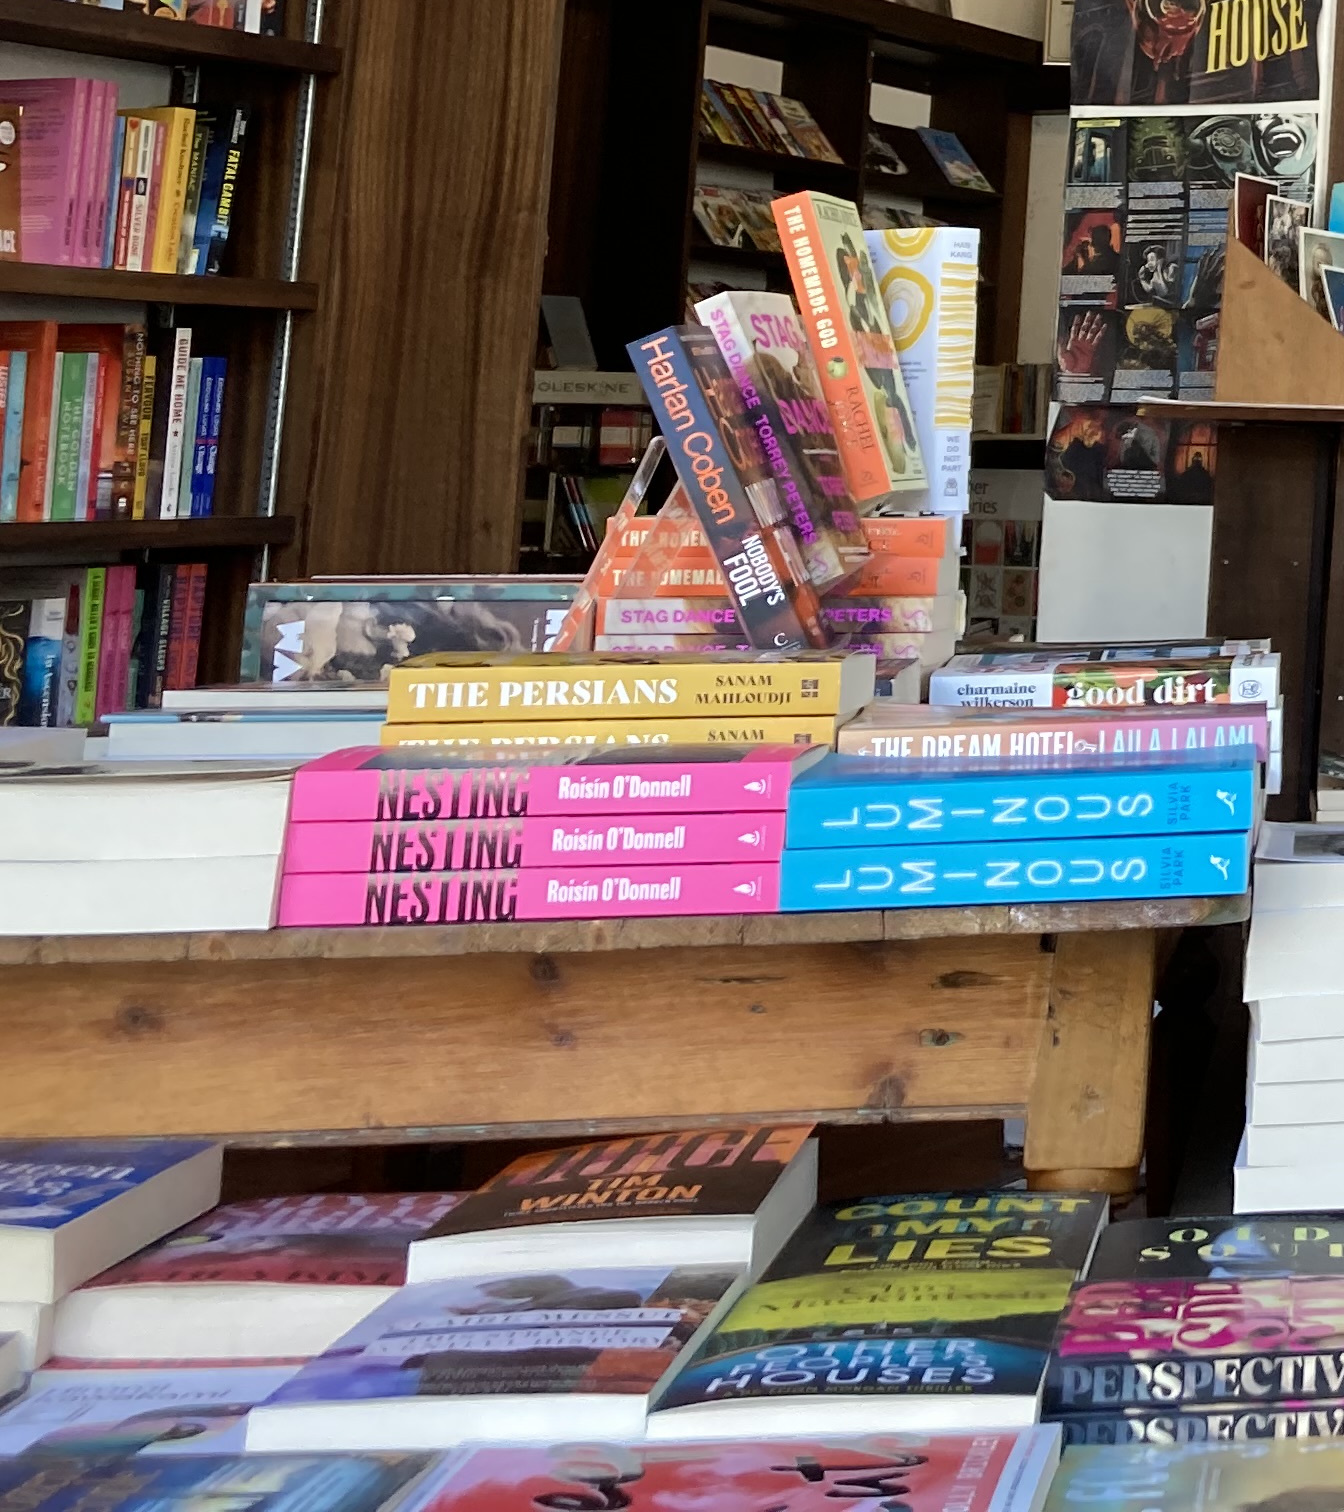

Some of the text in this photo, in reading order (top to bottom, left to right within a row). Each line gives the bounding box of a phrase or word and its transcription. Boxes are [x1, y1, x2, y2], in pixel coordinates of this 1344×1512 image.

[216, 149, 240, 226] FATAL GAMBIT
[783, 204, 839, 350] THE HOMEMADE GOD
[750, 313, 798, 350] STAG
[127, 332, 144, 455] NOTHING TO SEE HERE
[171, 338, 188, 424] GUIDE ME HOME
[641, 334, 737, 526] Harlan Coben
[710, 309, 817, 545] STAG DANCE TORREY PETERS
[845, 385, 874, 453] RACHEL
[57, 400, 72, 486] NOTEBOOK
[945, 445, 960, 453] DO
[946, 435, 961, 443] WE
[67, 428, 80, 492] GOLDEN
[941, 464, 962, 473] PART
[723, 551, 759, 607] FOOL
[741, 533, 786, 606] NOBODY'S
[621, 607, 736, 625] STAG DANCE
[408, 678, 679, 710] THE PERSIANS
[695, 690, 793, 706] MAHLOUDJI
[714, 675, 774, 688] SANAM
[956, 681, 1037, 697] charmaine
[1064, 675, 1217, 710] good dirt
[960, 695, 1035, 708] wilkerson
[706, 728, 766, 743] SANAM
[871, 722, 1254, 757] THE DREAM HOTEL LAILA LALAMI
[376, 769, 691, 821] NESTING O'Donnell
[822, 791, 1154, 832] LUMINOUS
[1166, 781, 1179, 825] SILVIA
[1179, 784, 1192, 821] PARK
[370, 822, 686, 873] NESTING O'Donnell
[814, 857, 1147, 894] LUMINOUS
[1159, 846, 1173, 891] SILVIA
[1173, 849, 1186, 888] PARK
[364, 874, 681, 926] NESTING O'Donnell
[520, 1184, 704, 1213] WINTON
[587, 1174, 664, 1190] TIM
[834, 1196, 1093, 1224] COUNT
[893, 1216, 1013, 1237] MY
[823, 1236, 1052, 1266] LIES
[1167, 1225, 1331, 1244] OLD
[730, 1353, 989, 1377] PEOPLE'S
[755, 1338, 978, 1361] OTHER
[705, 1366, 996, 1394] HOUSES
